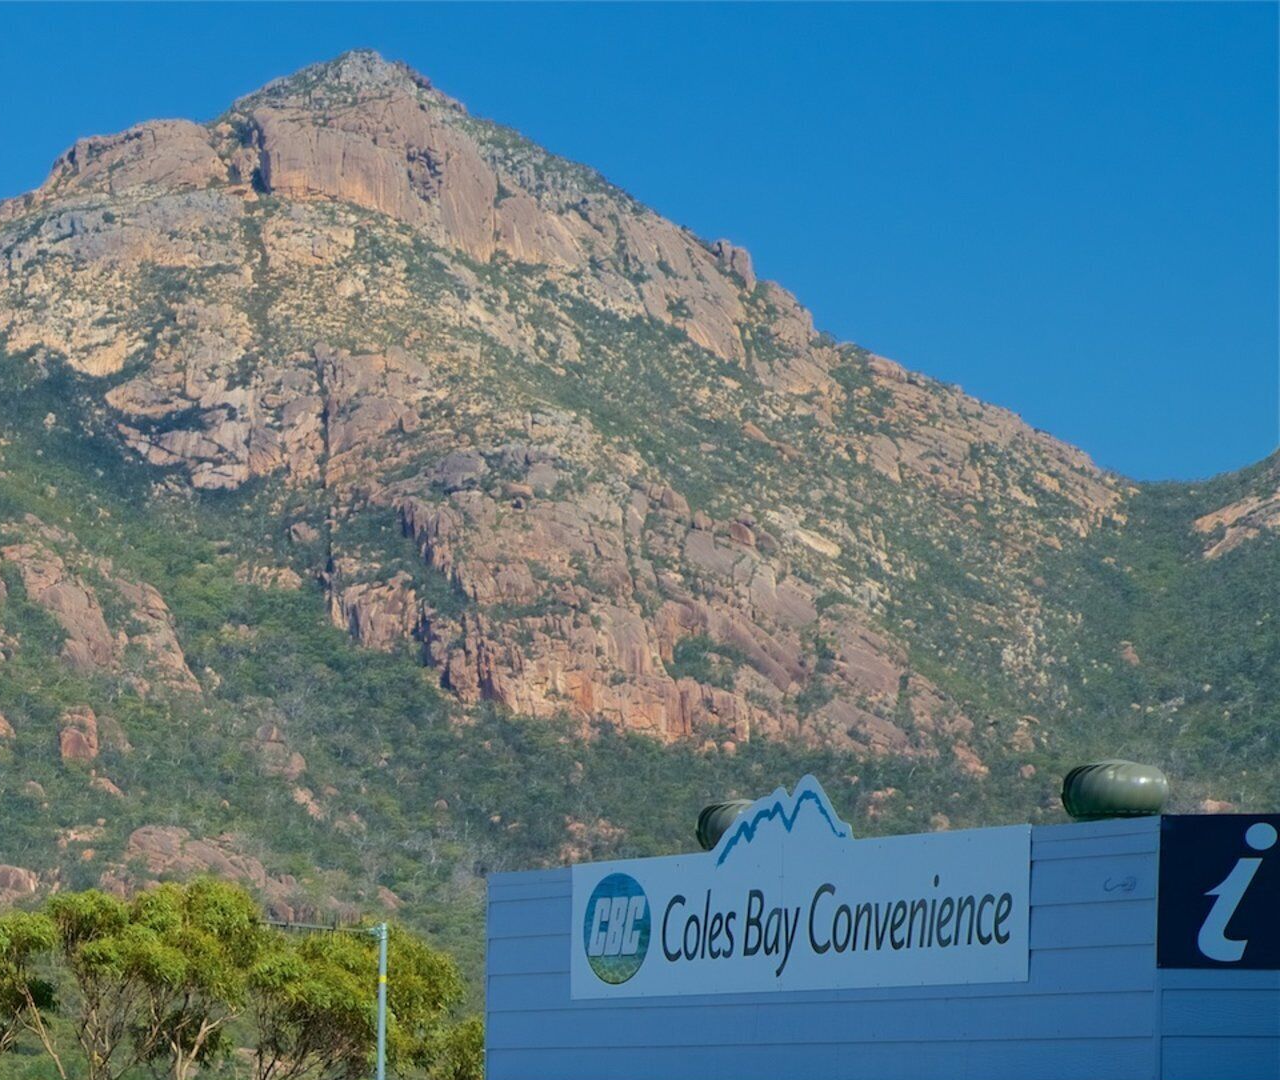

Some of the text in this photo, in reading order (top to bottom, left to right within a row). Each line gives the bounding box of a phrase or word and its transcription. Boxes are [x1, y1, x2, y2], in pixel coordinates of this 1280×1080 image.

[587, 895, 644, 957] CBC
[662, 874, 1013, 977] Coles Bay Convenience
